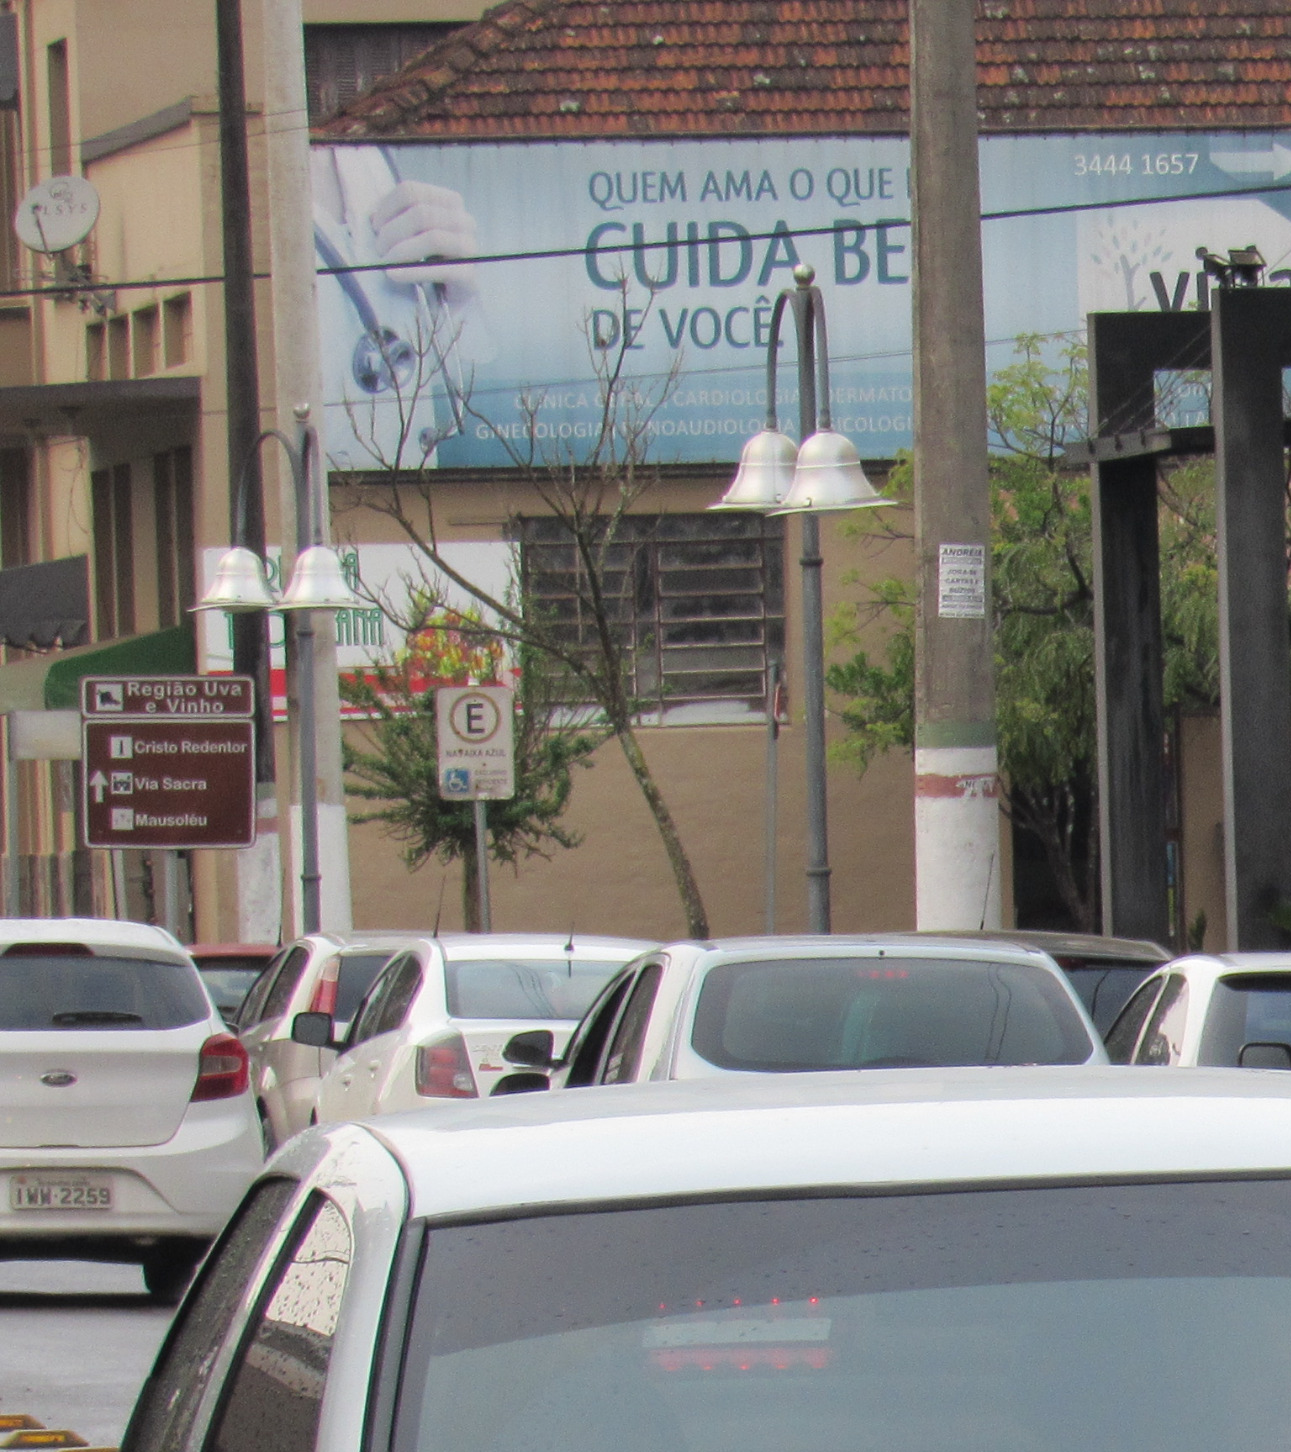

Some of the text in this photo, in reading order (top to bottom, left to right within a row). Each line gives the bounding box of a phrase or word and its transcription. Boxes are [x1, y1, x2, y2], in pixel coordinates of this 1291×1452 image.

[1075, 154, 1199, 176] 3444 1657
[588, 169, 687, 210] QUEM
[700, 169, 778, 201] AMA
[789, 168, 814, 201] O
[826, 167, 893, 207] QUE
[584, 218, 910, 291] CUIDA BE
[592, 308, 645, 350] DE
[127, 681, 241, 700] Região Uva
[145, 699, 224, 713] e Vinho
[466, 703, 486, 734] E
[134, 741, 247, 754] Cristo Redentor
[135, 777, 207, 790] Via Sacra
[135, 814, 207, 826] Mausoléu
